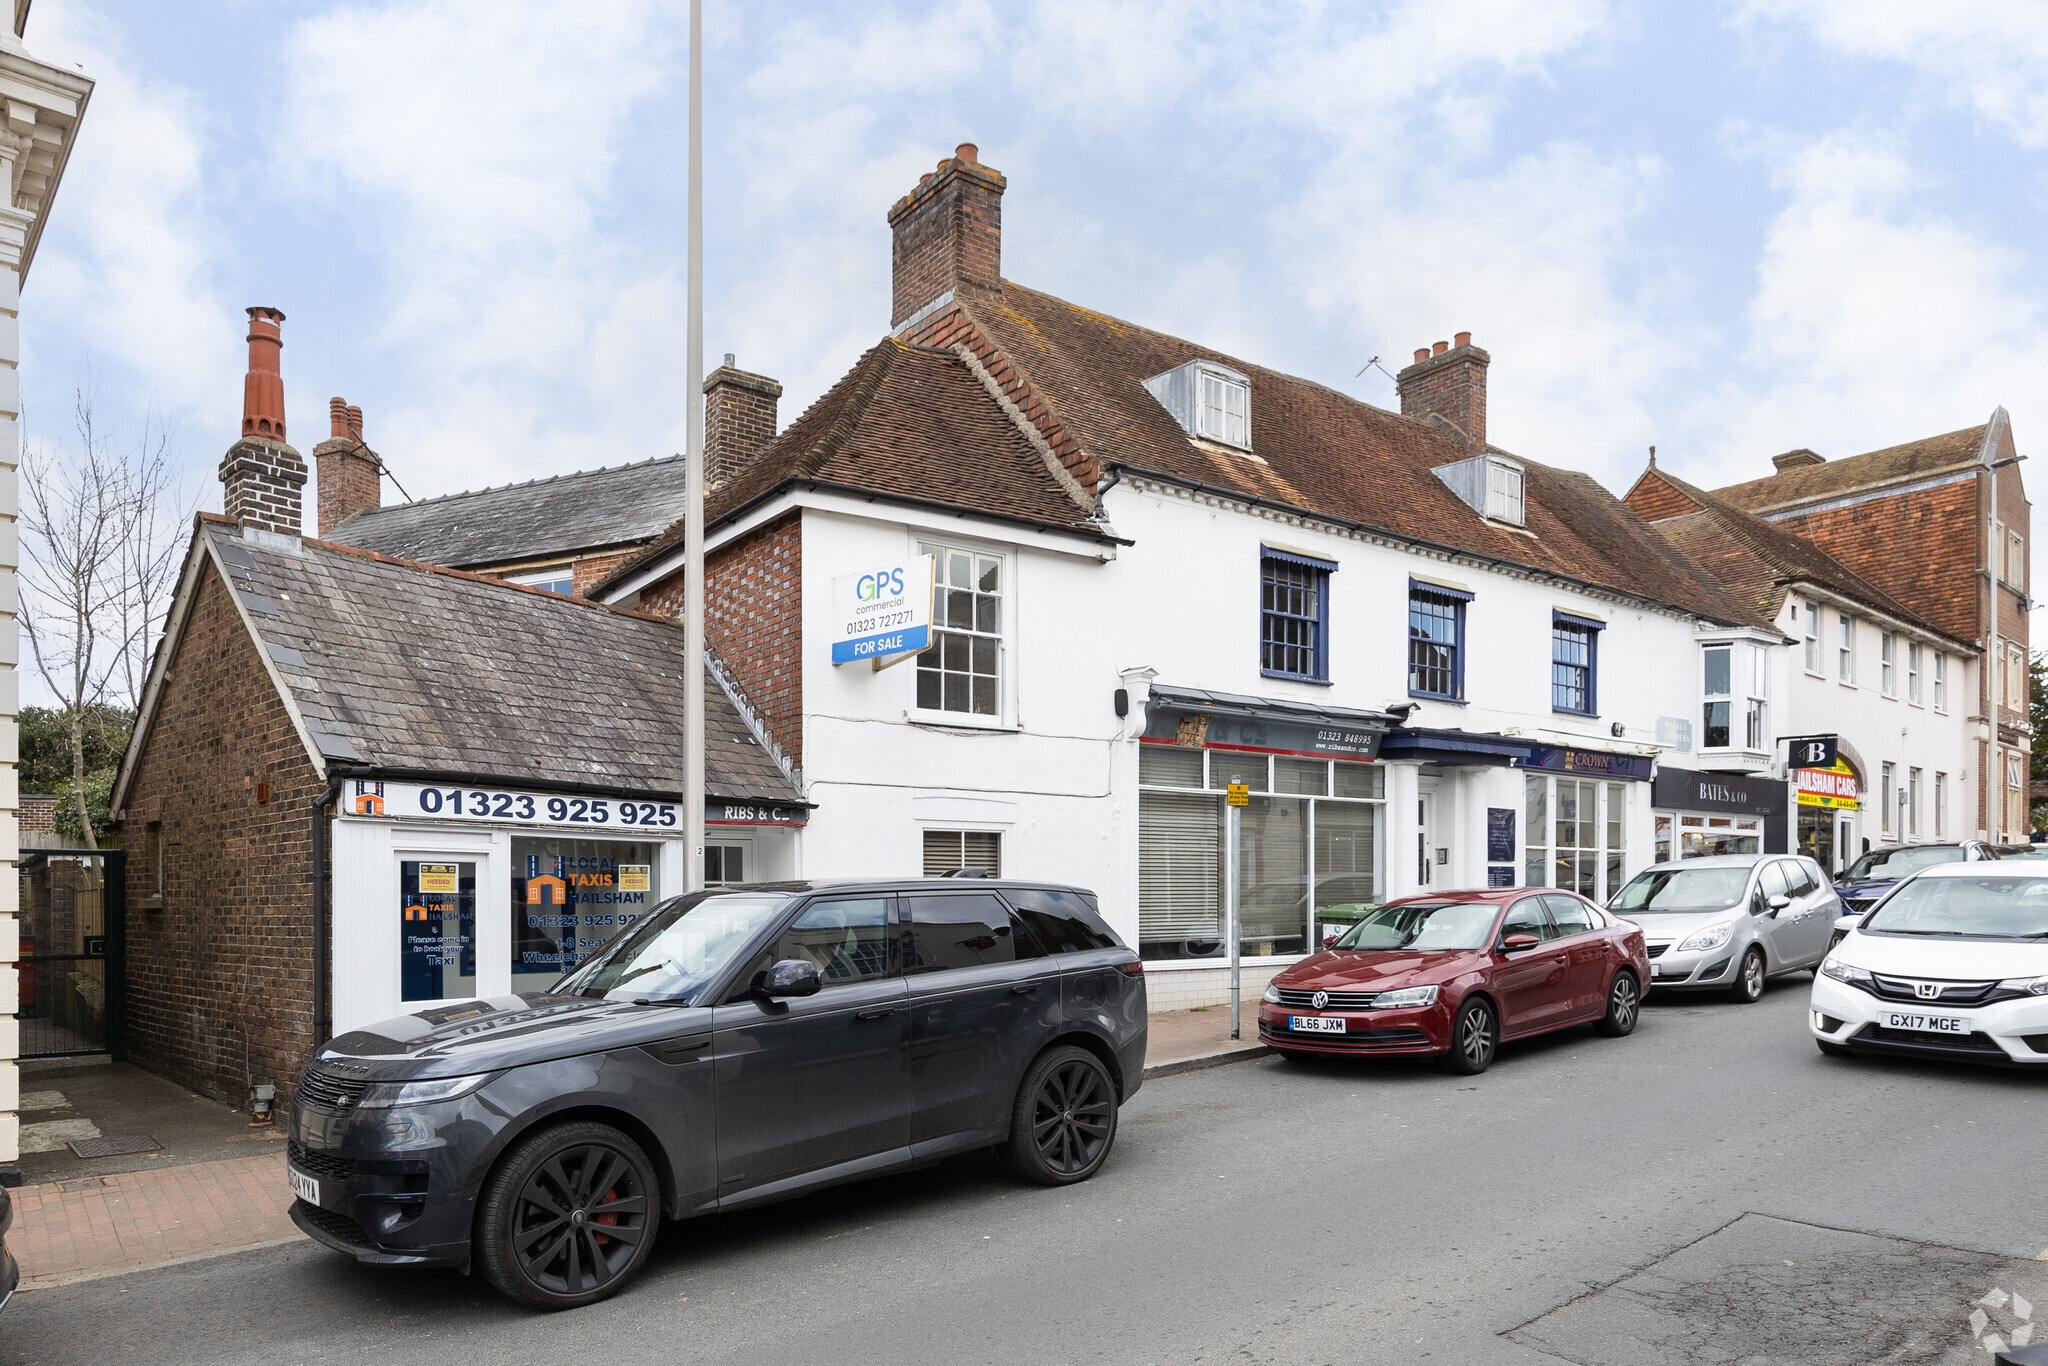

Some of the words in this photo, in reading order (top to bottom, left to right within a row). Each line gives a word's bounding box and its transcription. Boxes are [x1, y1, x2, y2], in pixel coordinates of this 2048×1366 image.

[856, 567, 904, 602] GPS
[856, 596, 904, 615] commercial
[846, 617, 876, 635] 01323
[879, 610, 914, 628] 727271
[854, 641, 875, 656] FOR
[877, 635, 903, 651] SALE
[1317, 730, 1341, 742] 01323
[1344, 733, 1372, 745] 848995
[1807, 742, 1826, 763] B
[1575, 753, 1609, 768] CROWN
[1699, 782, 1730, 802] BATES
[1737, 792, 1747, 804] CO
[1836, 776, 1857, 797] CARS
[419, 788, 536, 820] 01323
[547, 798, 609, 823] 925
[619, 803, 676, 826] 925
[725, 805, 754, 820] RIBS
[758, 807, 768, 820] &
[697, 847, 703, 855] 2
[569, 857, 619, 869] LOCAL
[568, 873, 613, 887] TAXIS
[569, 892, 645, 904] HAILSHAM
[428, 904, 454, 912] TAXIS
[527, 914, 579, 929] 01323
[584, 914, 614, 927] 925
[618, 914, 641, 927] 92
[407, 935, 437, 944] Please
[437, 936, 460, 944] come
[460, 935, 470, 943] in
[555, 937, 575, 949] 1-8
[413, 945, 424, 953] to
[424, 944, 444, 953] book
[446, 945, 464, 955] your
[522, 950, 591, 964] Wheelchai
[425, 954, 455, 966] Taxi
[1294, 1017, 1320, 1030] BL66
[1322, 1019, 1344, 1031] JXM
[1890, 1014, 1924, 1029] GX17
[1929, 1017, 1960, 1032] MGE
[301, 1176, 317, 1202] YYA
